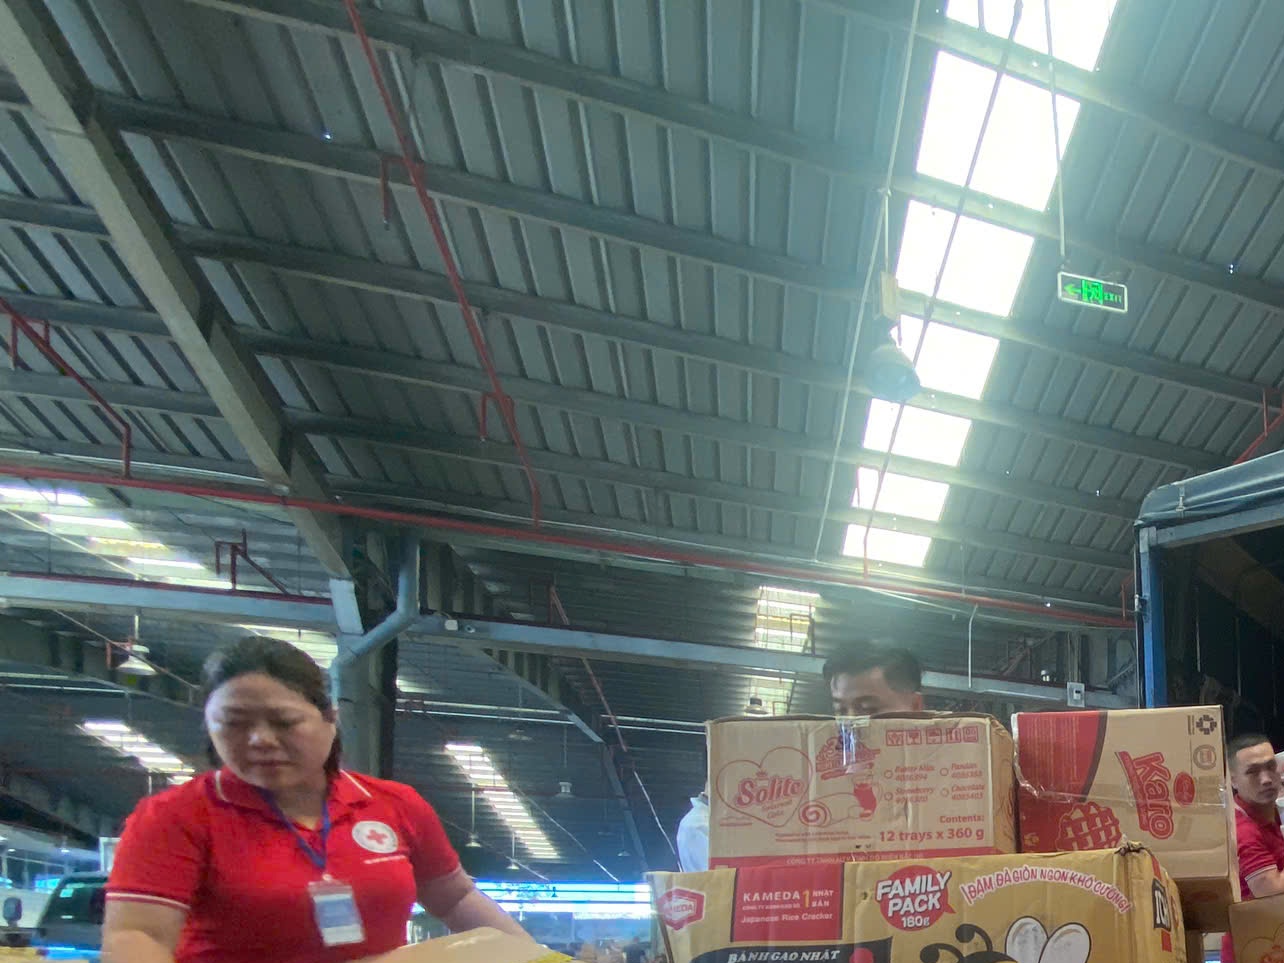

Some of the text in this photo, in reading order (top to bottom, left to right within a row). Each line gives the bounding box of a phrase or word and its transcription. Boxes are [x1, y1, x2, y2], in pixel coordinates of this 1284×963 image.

[735, 776, 804, 808] Solite
[1133, 752, 1174, 839] Karo
[940, 815, 985, 824] Contents:
[880, 831, 895, 842] 12
[898, 830, 932, 843] trays
[936, 831, 944, 840] x
[947, 828, 972, 840] 360
[976, 829, 985, 840] g
[1040, 869, 1068, 882] NGON
[877, 871, 951, 900] FAMILY
[743, 890, 800, 902] KAMEDA
[802, 890, 810, 908] 1
[887, 892, 941, 917] PACK
[741, 912, 833, 924] Japanese Rice Cracker
[901, 915, 930, 927] 180g
[727, 951, 769, 963] BÁNH
